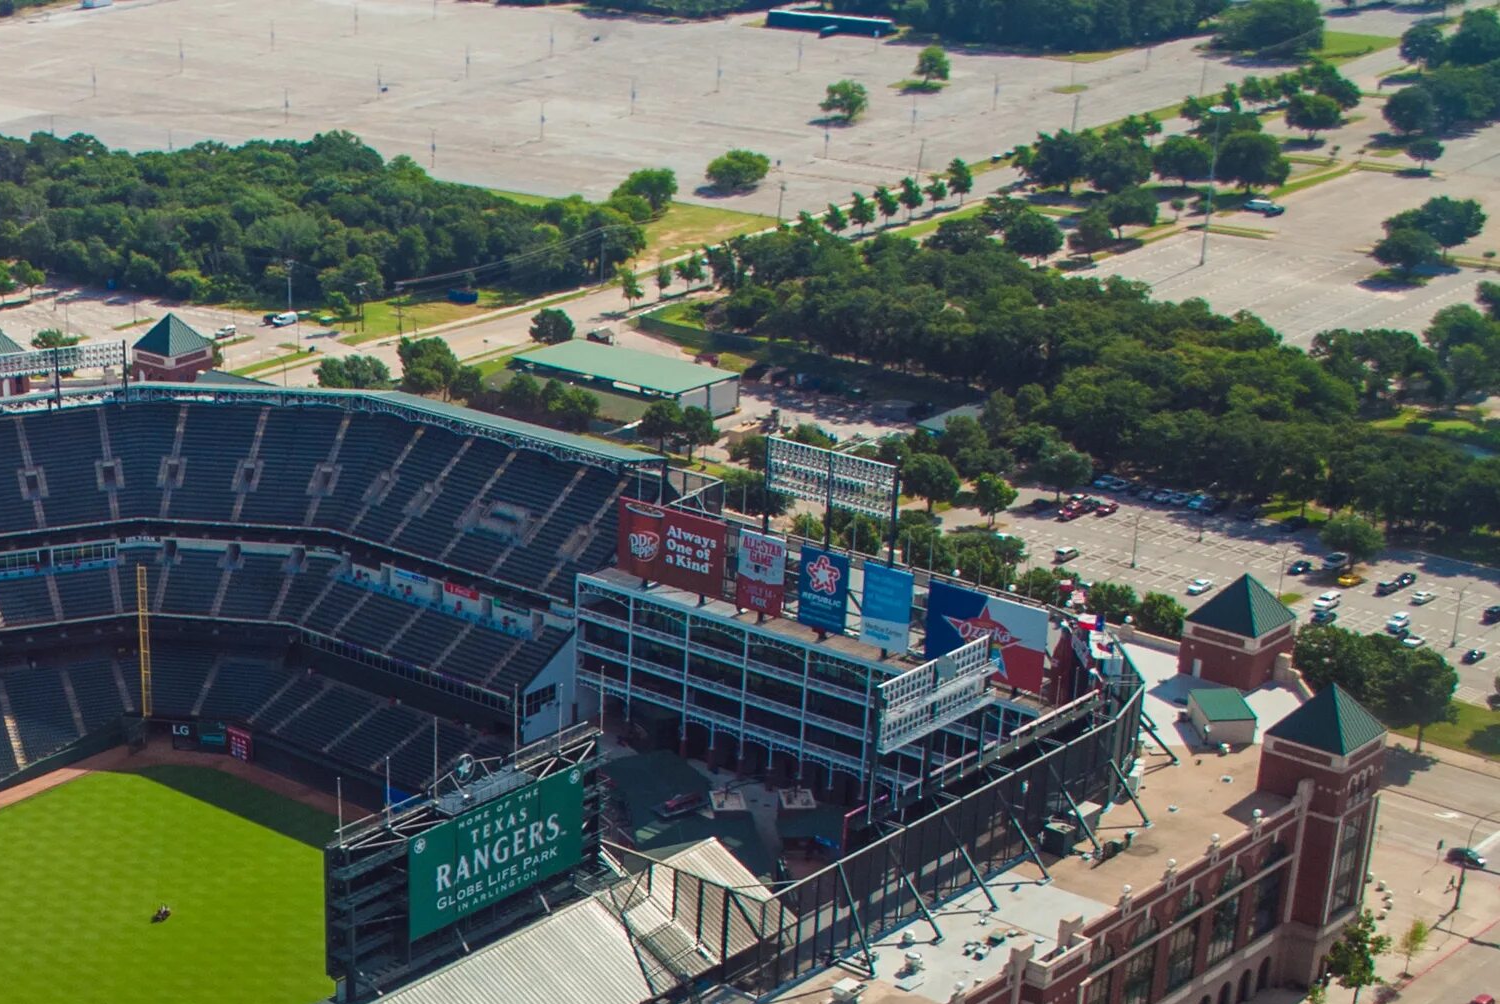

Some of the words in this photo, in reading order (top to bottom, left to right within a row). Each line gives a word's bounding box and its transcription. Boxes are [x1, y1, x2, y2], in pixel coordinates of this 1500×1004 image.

[667, 525, 717, 548] Always
[666, 539, 692, 555] One
[696, 549, 711, 561] of
[749, 550, 773, 567] GAME
[665, 555, 673, 563] a
[675, 554, 710, 574] Kind
[750, 596, 767, 608] FOX
[802, 591, 842, 607] REPUBLIC
[173, 724, 189, 736] LG
[458, 810, 491, 829] HOME
[496, 801, 512, 814] OF
[518, 787, 540, 804] THE
[470, 807, 529, 844] TEXAS
[435, 813, 562, 893] RANGERS
[436, 880, 484, 911] GLOBE
[487, 865, 519, 888] LIFE
[522, 846, 560, 868] PARK
[457, 901, 470, 913] IN
[472, 869, 539, 908] ARLINGTON
